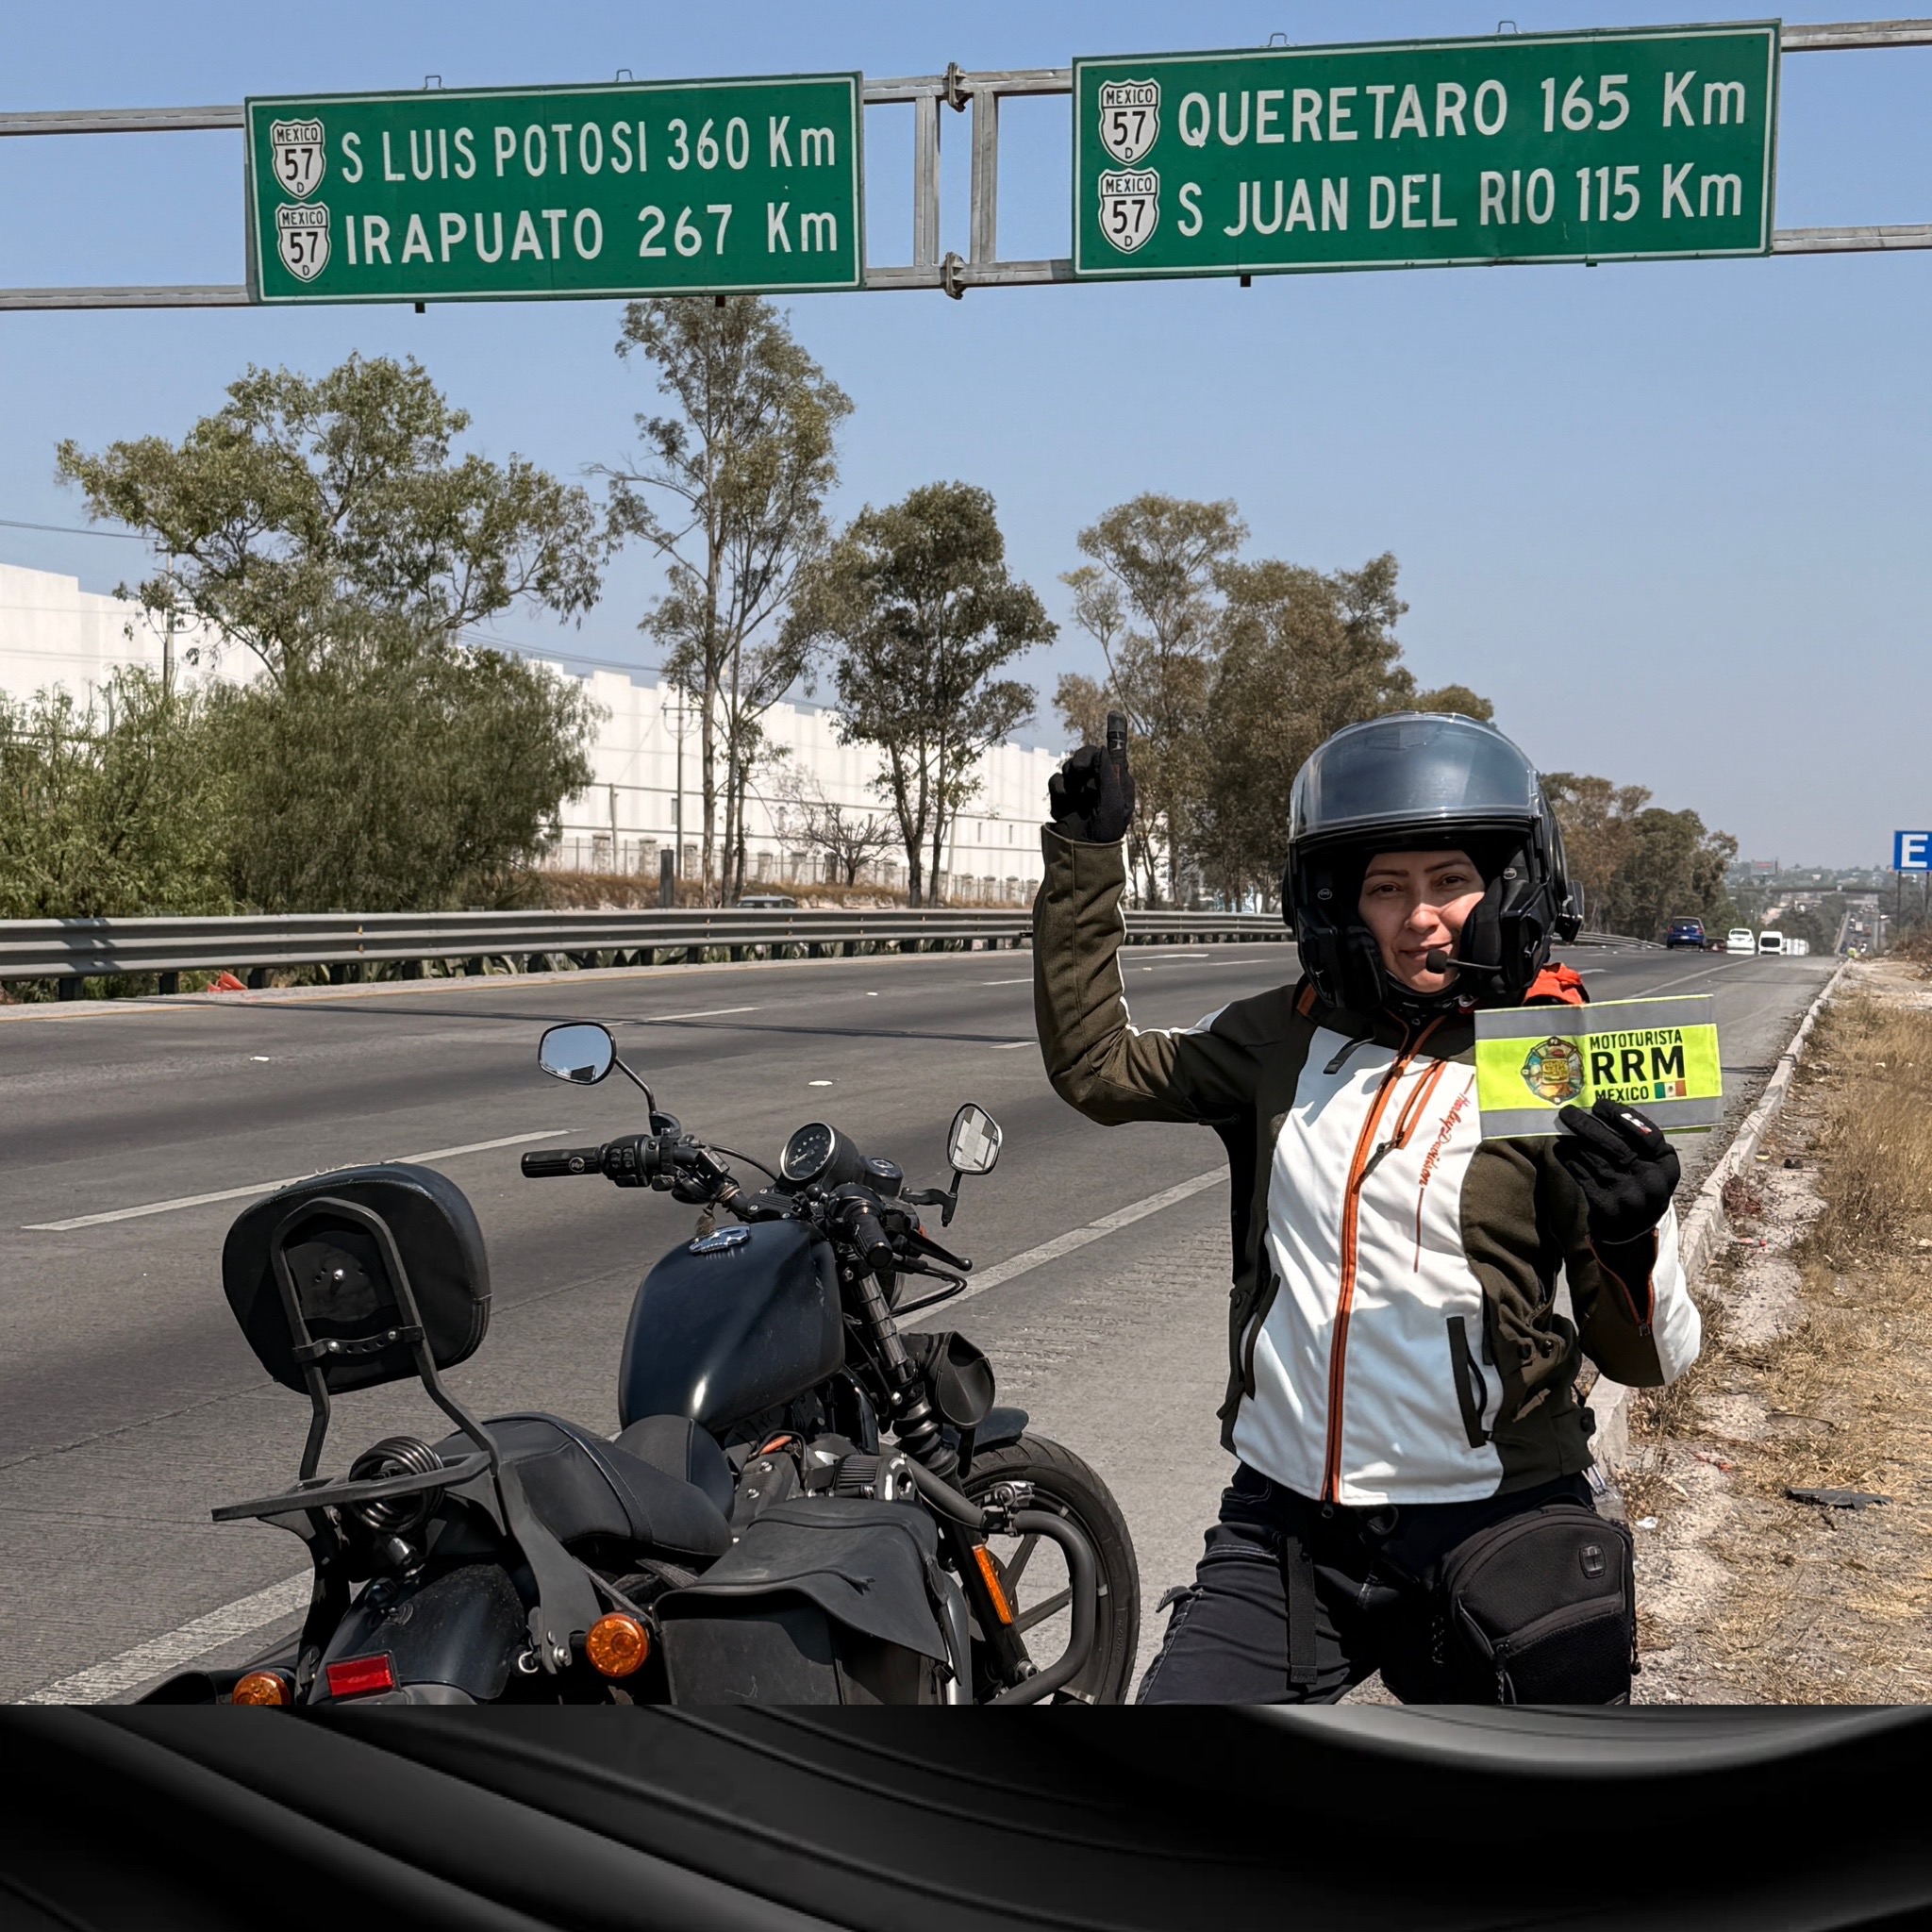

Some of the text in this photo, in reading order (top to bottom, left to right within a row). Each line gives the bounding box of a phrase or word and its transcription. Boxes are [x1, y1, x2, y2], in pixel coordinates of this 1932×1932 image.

[1105, 88, 1154, 106] MEXICO
[1178, 71, 1745, 148] QUERETARO 165 Km
[275, 126, 319, 143] MEXICO
[1112, 110, 1147, 147] 57
[341, 116, 836, 183] S LUIS POTOSI 360 Km
[1124, 146, 1133, 159] D
[284, 147, 313, 181] 57
[296, 181, 305, 193] D
[1105, 176, 1153, 194] MEXICO
[1177, 162, 1742, 237] S JUAN DEL RIO 115 Km
[281, 209, 325, 226] MEXICO
[1112, 199, 1147, 235] 57
[290, 230, 319, 264] 57
[345, 202, 837, 265] IRAPUATO 267 Km
[1124, 235, 1133, 247] D
[302, 264, 310, 276] D
[1902, 834, 1928, 868] E
[1590, 1029, 1683, 1051] MOTOTURISTA
[1591, 1045, 1686, 1086] RRM
[1594, 1086, 1649, 1102] MEXICO
